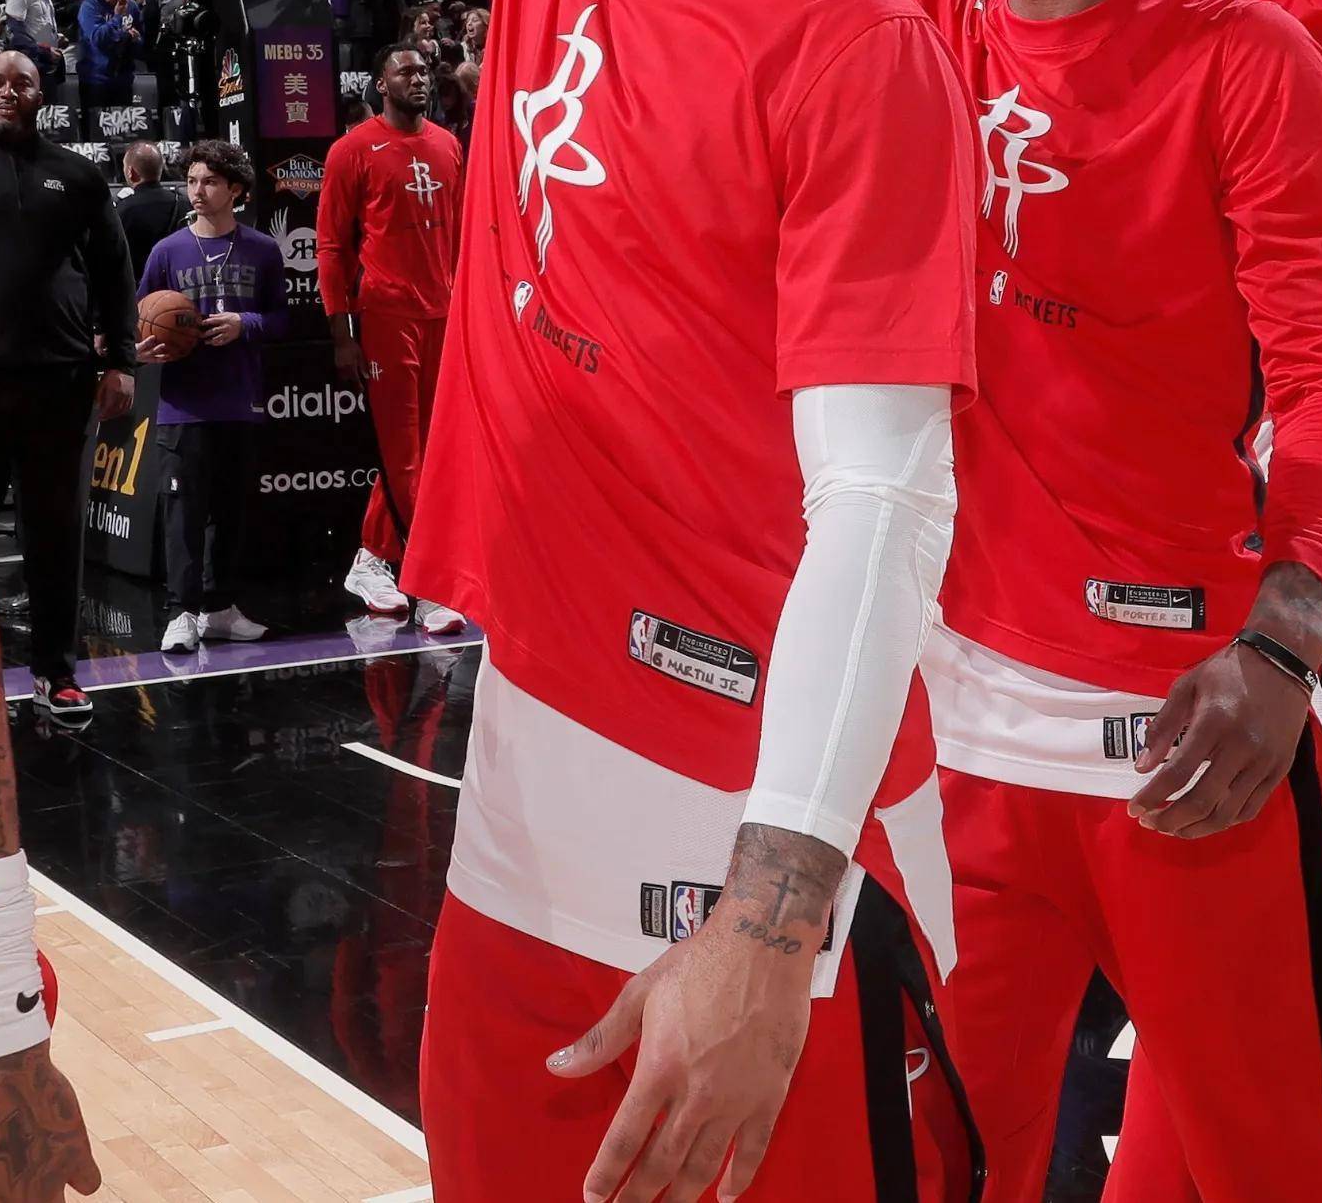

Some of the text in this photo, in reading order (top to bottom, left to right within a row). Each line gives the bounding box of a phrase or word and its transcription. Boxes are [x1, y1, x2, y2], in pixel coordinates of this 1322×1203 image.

[264, 44, 324, 60] MEBO 35
[99, 107, 147, 127] ROAR
[277, 167, 325, 180] DIAMOND
[289, 159, 313, 171] BLUE
[280, 181, 323, 190] ALMOND
[259, 467, 380, 494] SOCIOS.CO
[97, 501, 131, 540] Union
[1108, 606, 1118, 619] 3
[1122, 609, 1167, 622] PORTER
[680, 635, 729, 656] ENGINEERED
[652, 652, 663, 668] 6
[667, 659, 715, 686] MARTIN
[719, 678, 745, 695] JR.
